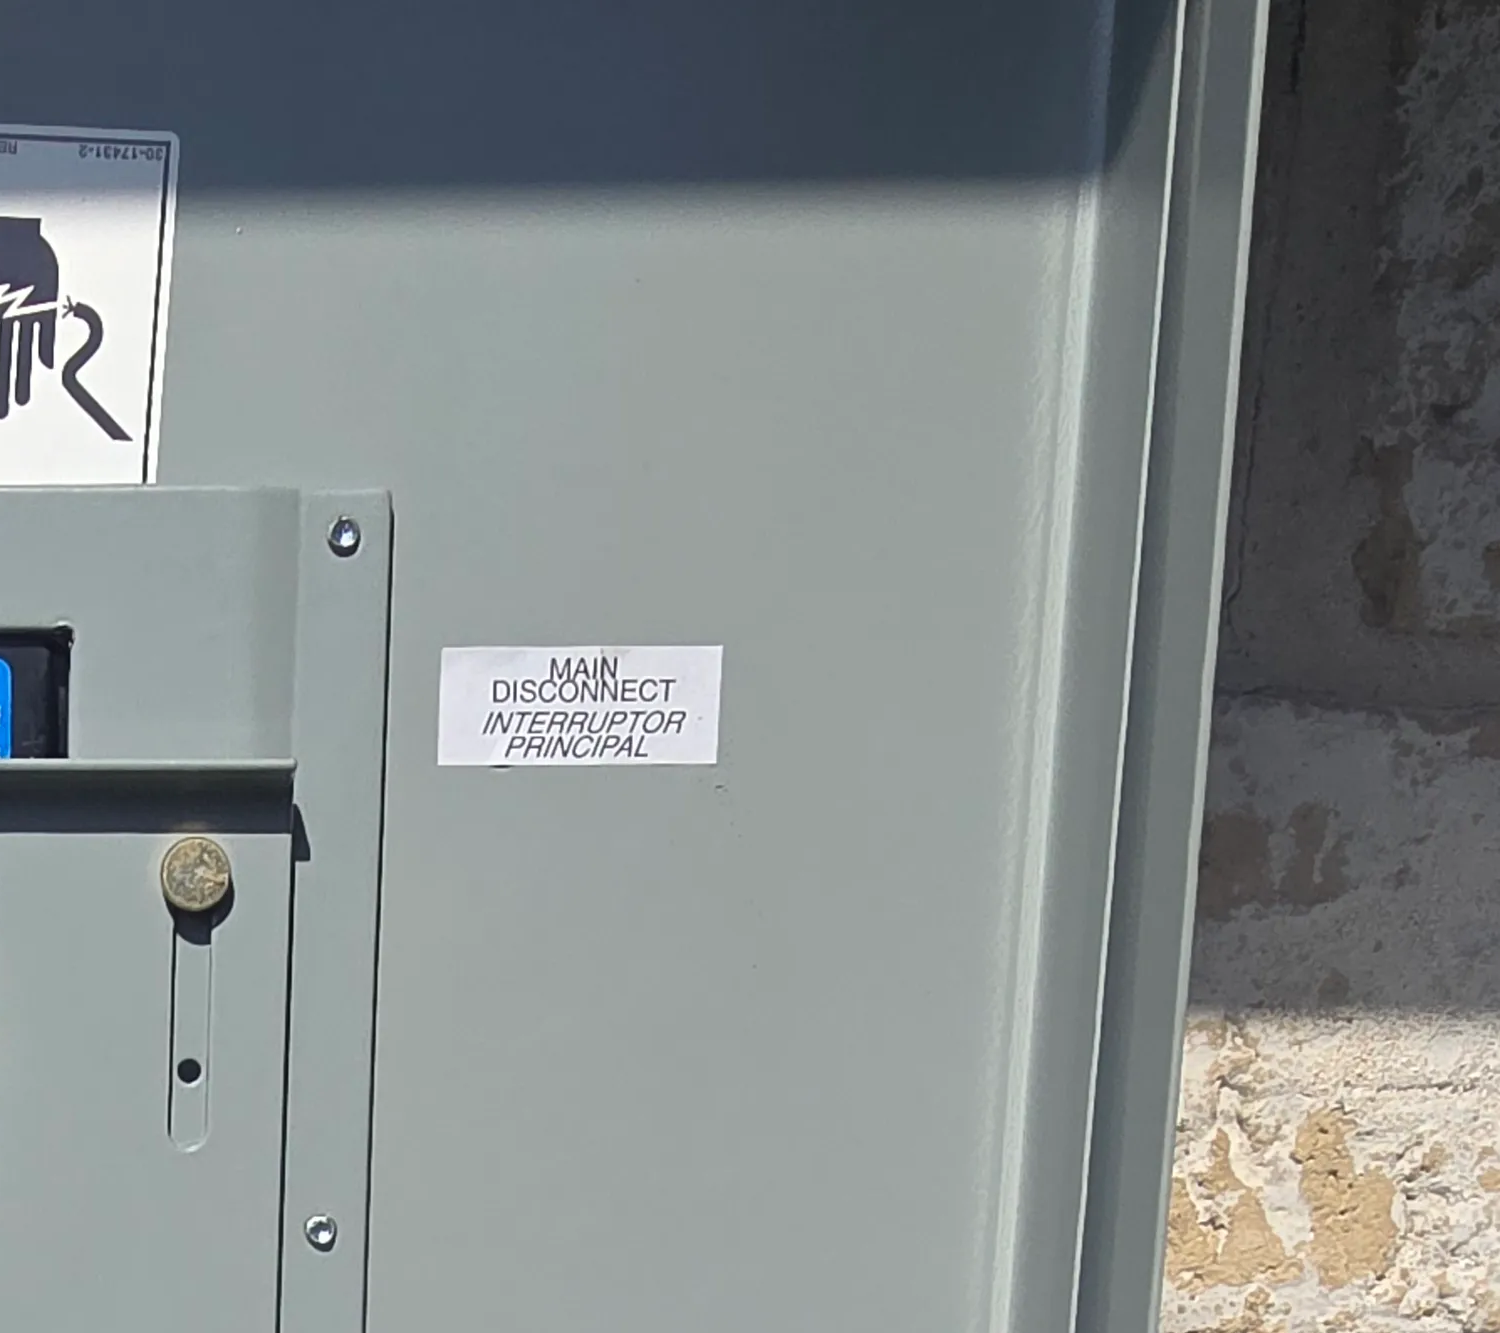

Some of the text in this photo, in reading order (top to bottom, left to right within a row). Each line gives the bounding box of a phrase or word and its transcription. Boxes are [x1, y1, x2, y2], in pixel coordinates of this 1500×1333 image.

[550, 657, 618, 680] MAIN
[492, 679, 677, 703] DISCONNECT
[482, 711, 686, 734] INTERRUPTOR
[505, 736, 649, 758] PRINCIPAL
